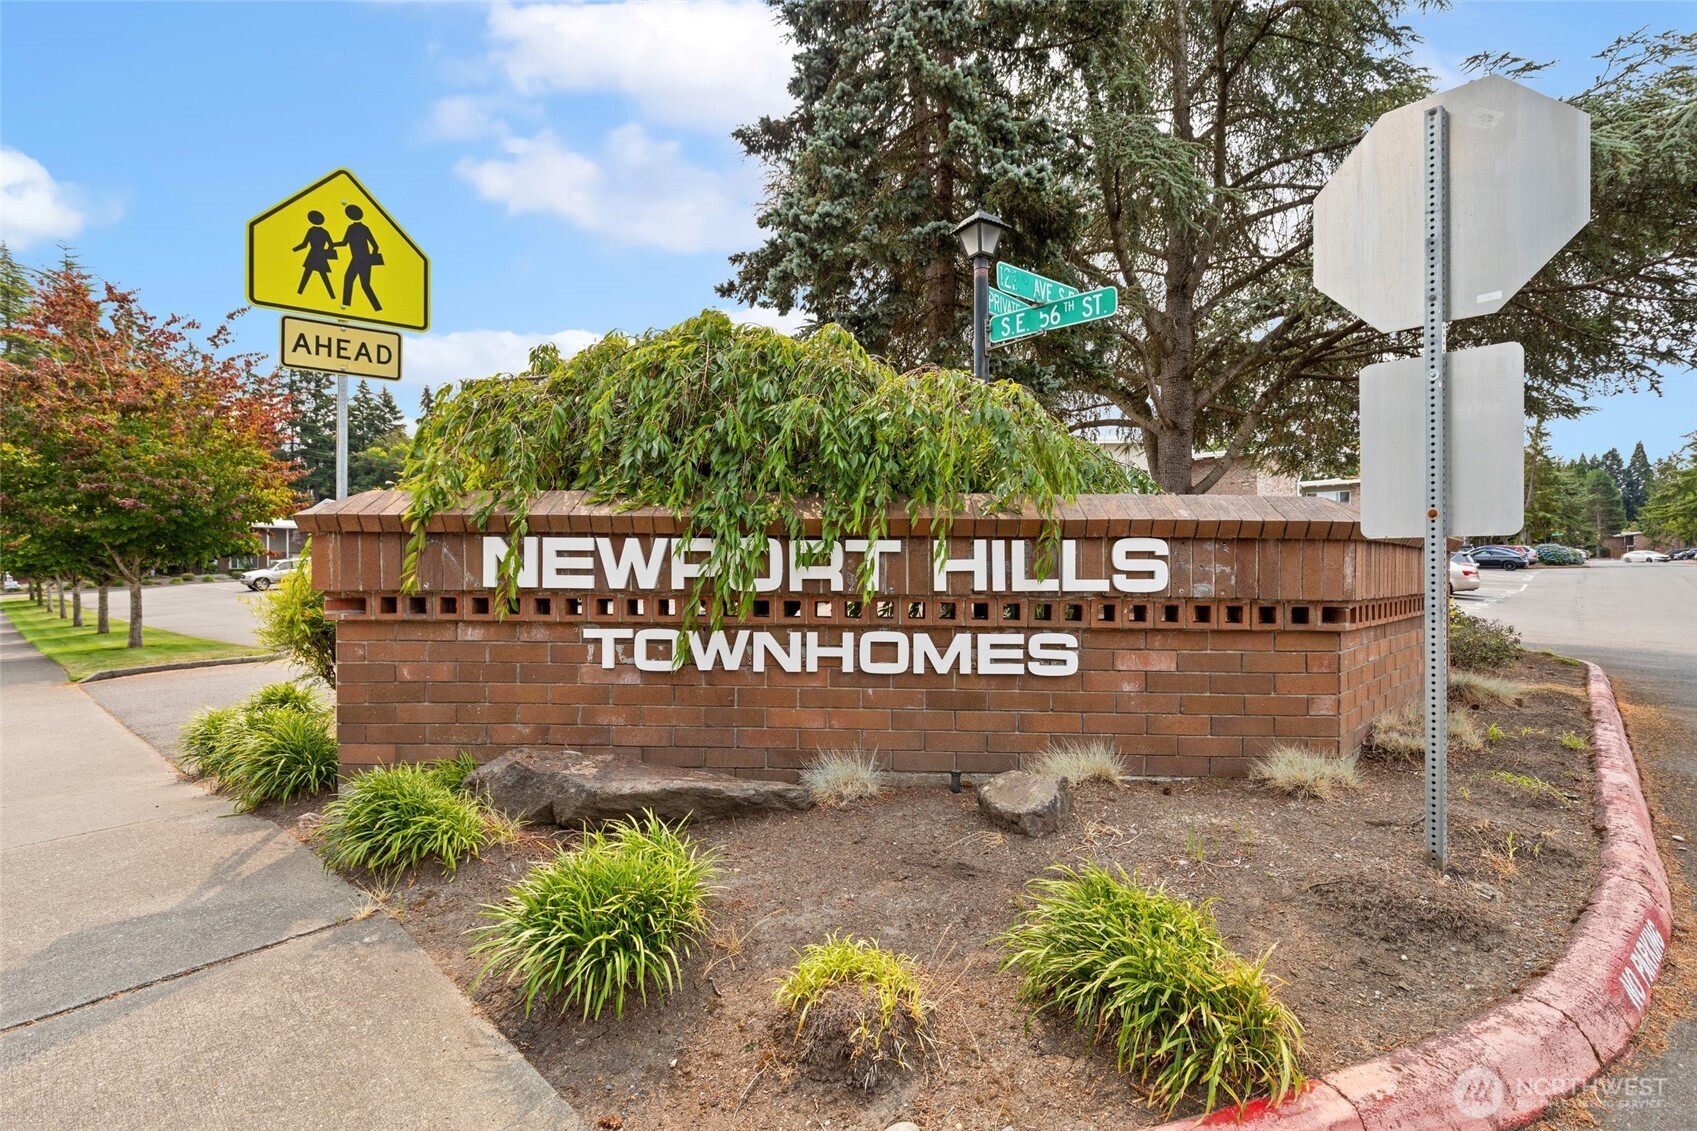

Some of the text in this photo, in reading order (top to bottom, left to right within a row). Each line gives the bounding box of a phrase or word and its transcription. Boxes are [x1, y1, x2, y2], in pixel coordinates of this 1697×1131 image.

[1033, 279, 1053, 303] AVE
[1001, 313, 1030, 337] S.E.
[1082, 293, 1108, 318] ST.
[291, 332, 393, 365] AHEAD
[482, 536, 1169, 592] NEWPORT HILLS
[583, 628, 1079, 677] TOWNHOMES
[1618, 966, 1647, 1012] NO
